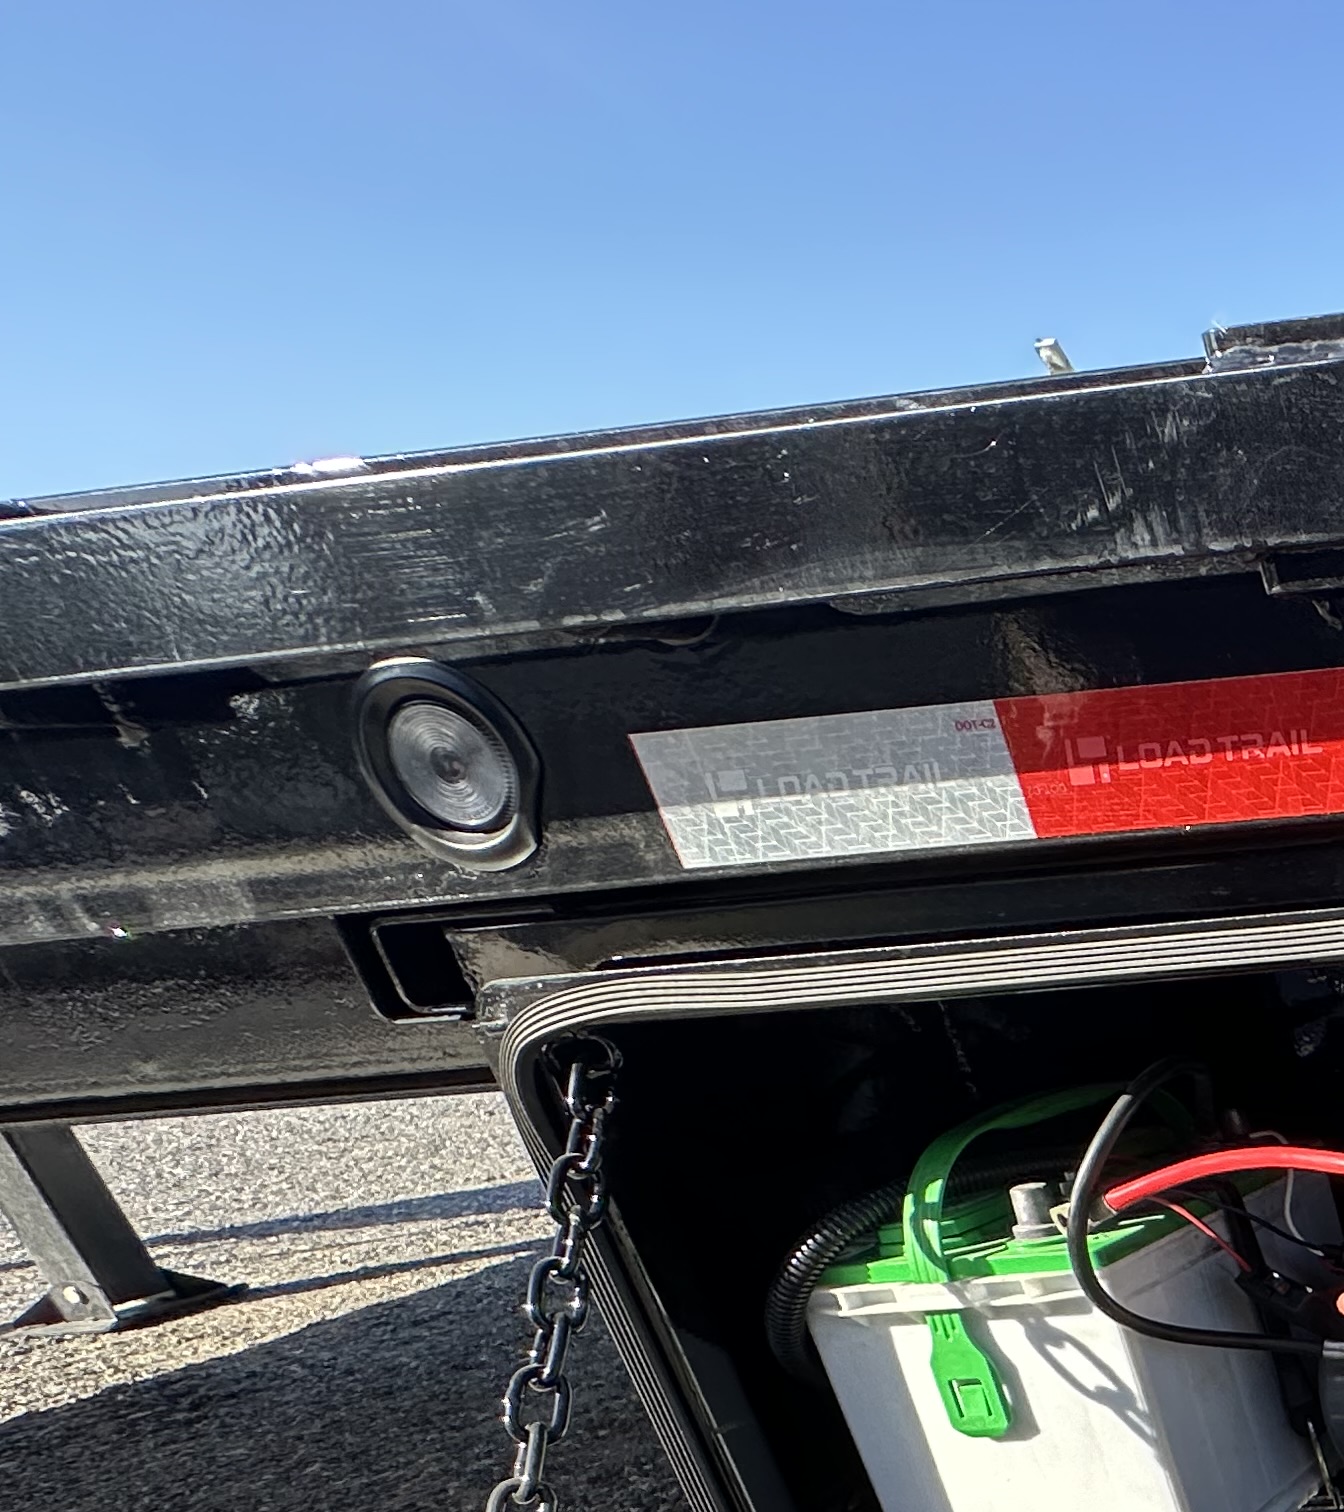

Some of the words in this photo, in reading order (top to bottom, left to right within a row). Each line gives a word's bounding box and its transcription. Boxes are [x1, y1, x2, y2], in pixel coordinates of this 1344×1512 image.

[955, 718, 996, 731] DOT-C2
[1117, 738, 1213, 770] LOAD
[1217, 729, 1323, 762] TRAIL
[756, 770, 850, 802] LOAD
[852, 761, 953, 792] TRAIL
